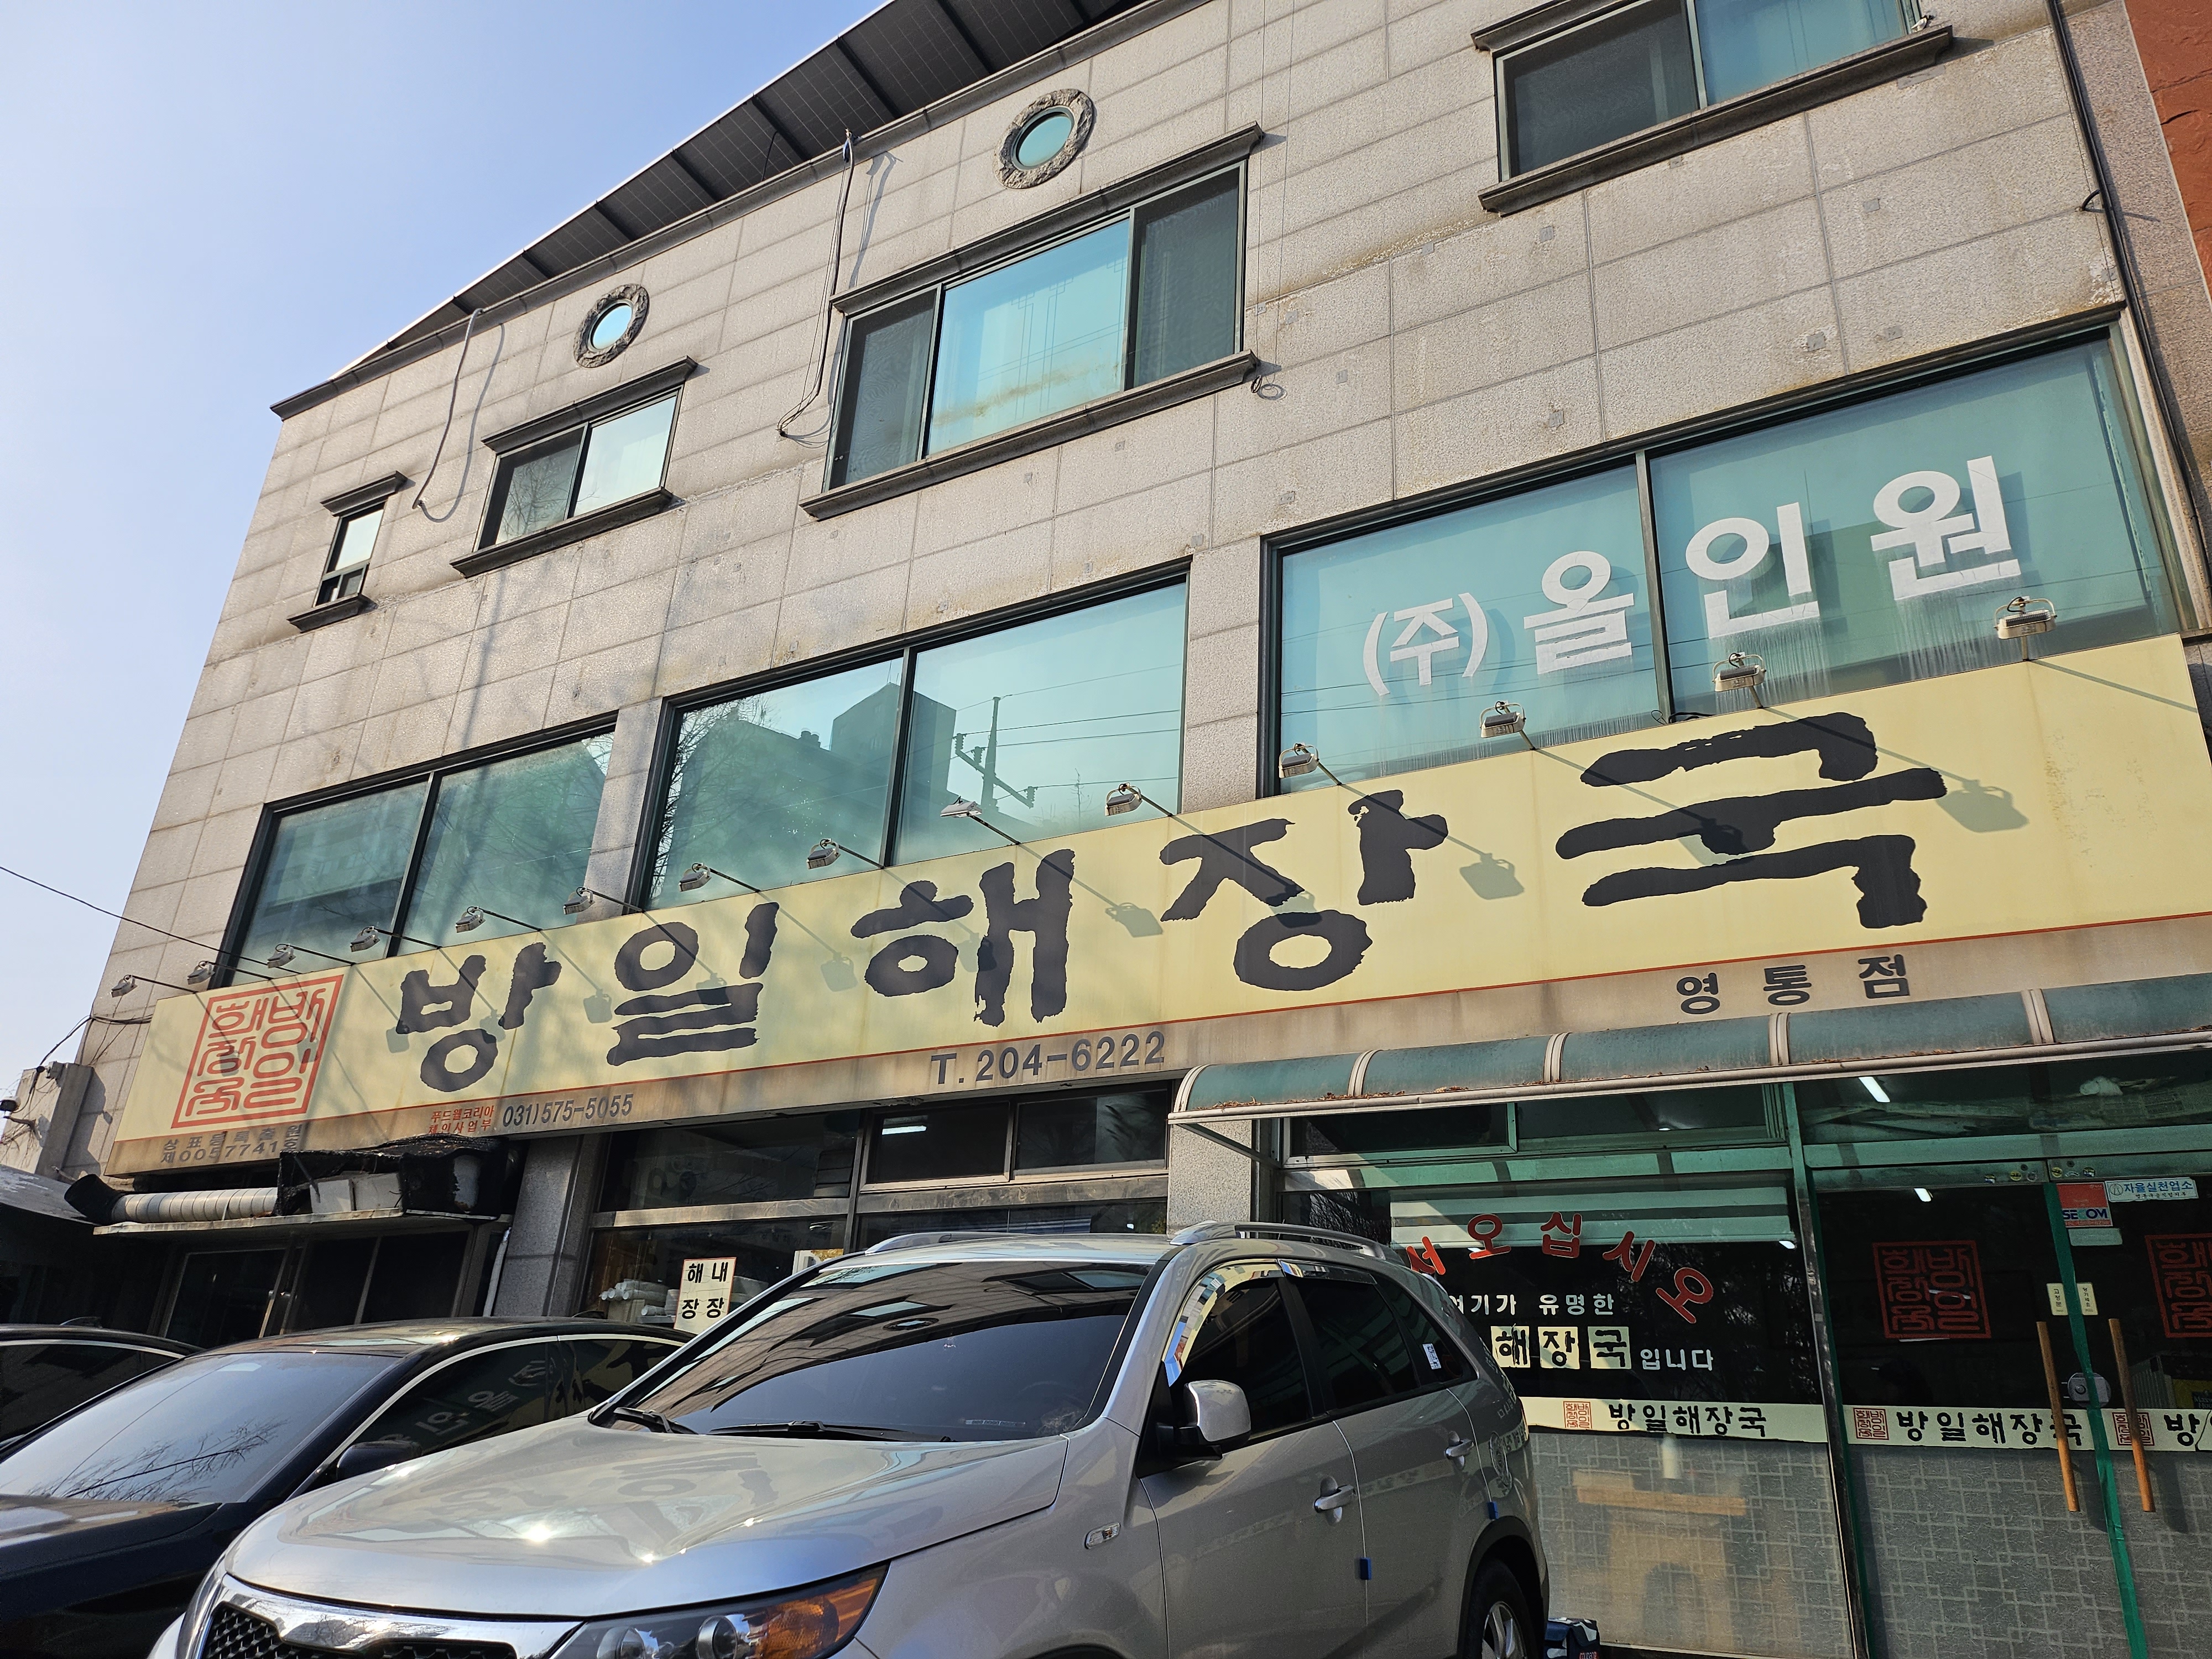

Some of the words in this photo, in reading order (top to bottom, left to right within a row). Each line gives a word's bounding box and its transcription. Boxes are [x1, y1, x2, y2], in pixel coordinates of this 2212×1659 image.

[396, 711, 1947, 1092] 방일해장국
[1676, 953, 1911, 1015] 영통점
[975, 1031, 1165, 1082] 204-6222
[503, 1094, 634, 1127] 031)575-5055
[2124, 1180, 2194, 1193] 자율실천업소
[1539, 1294, 1614, 1314] 유명한
[1608, 1403, 1766, 1437] 방일해장국
